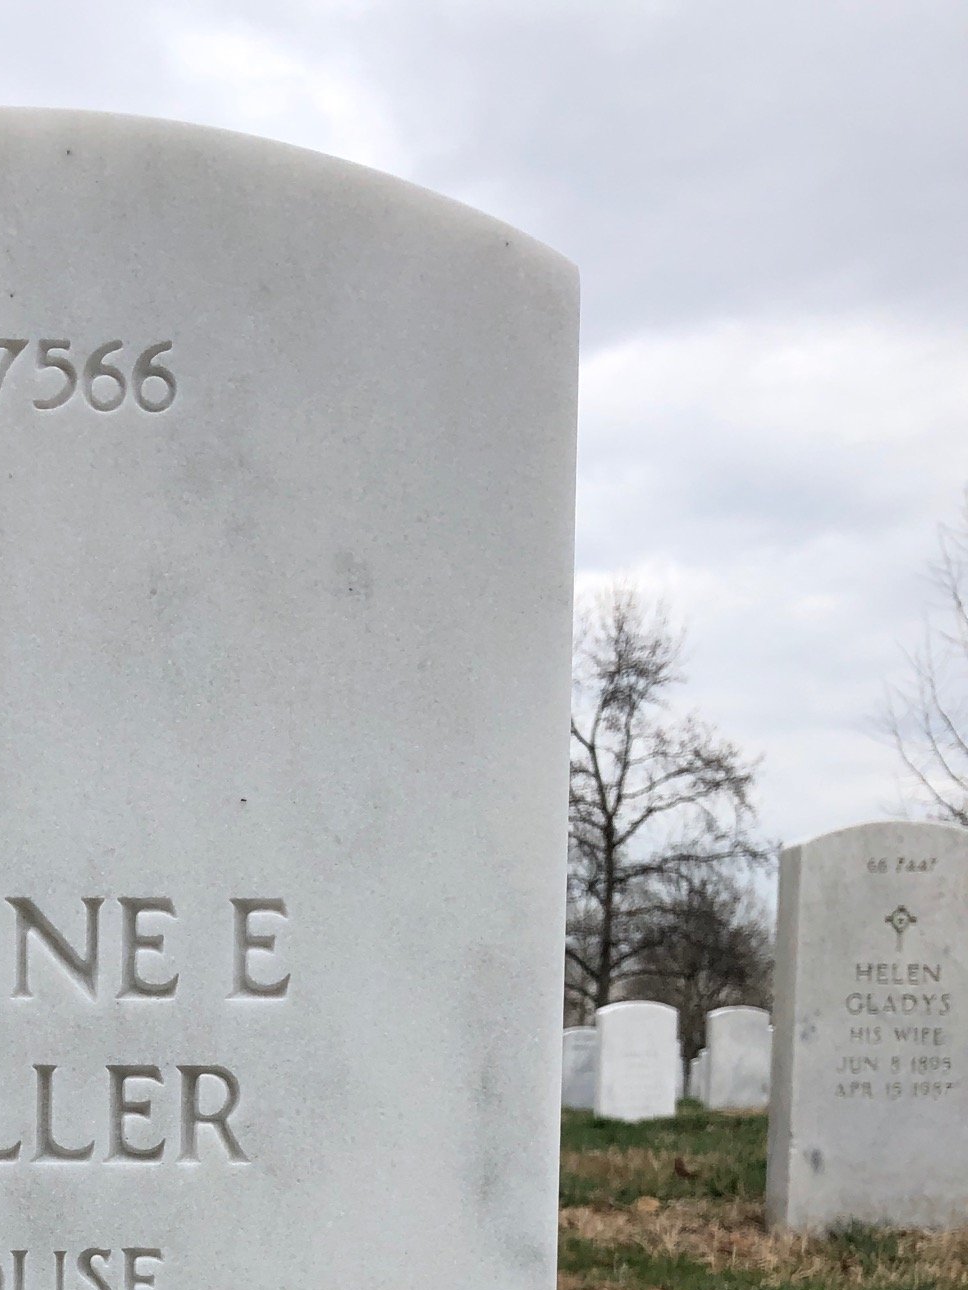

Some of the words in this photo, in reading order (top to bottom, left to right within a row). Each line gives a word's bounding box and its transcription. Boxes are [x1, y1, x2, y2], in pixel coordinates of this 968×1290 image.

[227, 897, 291, 1000] E
[855, 962, 941, 986] HELEN
[845, 992, 953, 1016] GLADYS
[849, 1026, 881, 1044] HIS
[893, 1027, 944, 1046] WIFE
[835, 1056, 879, 1075] JUN
